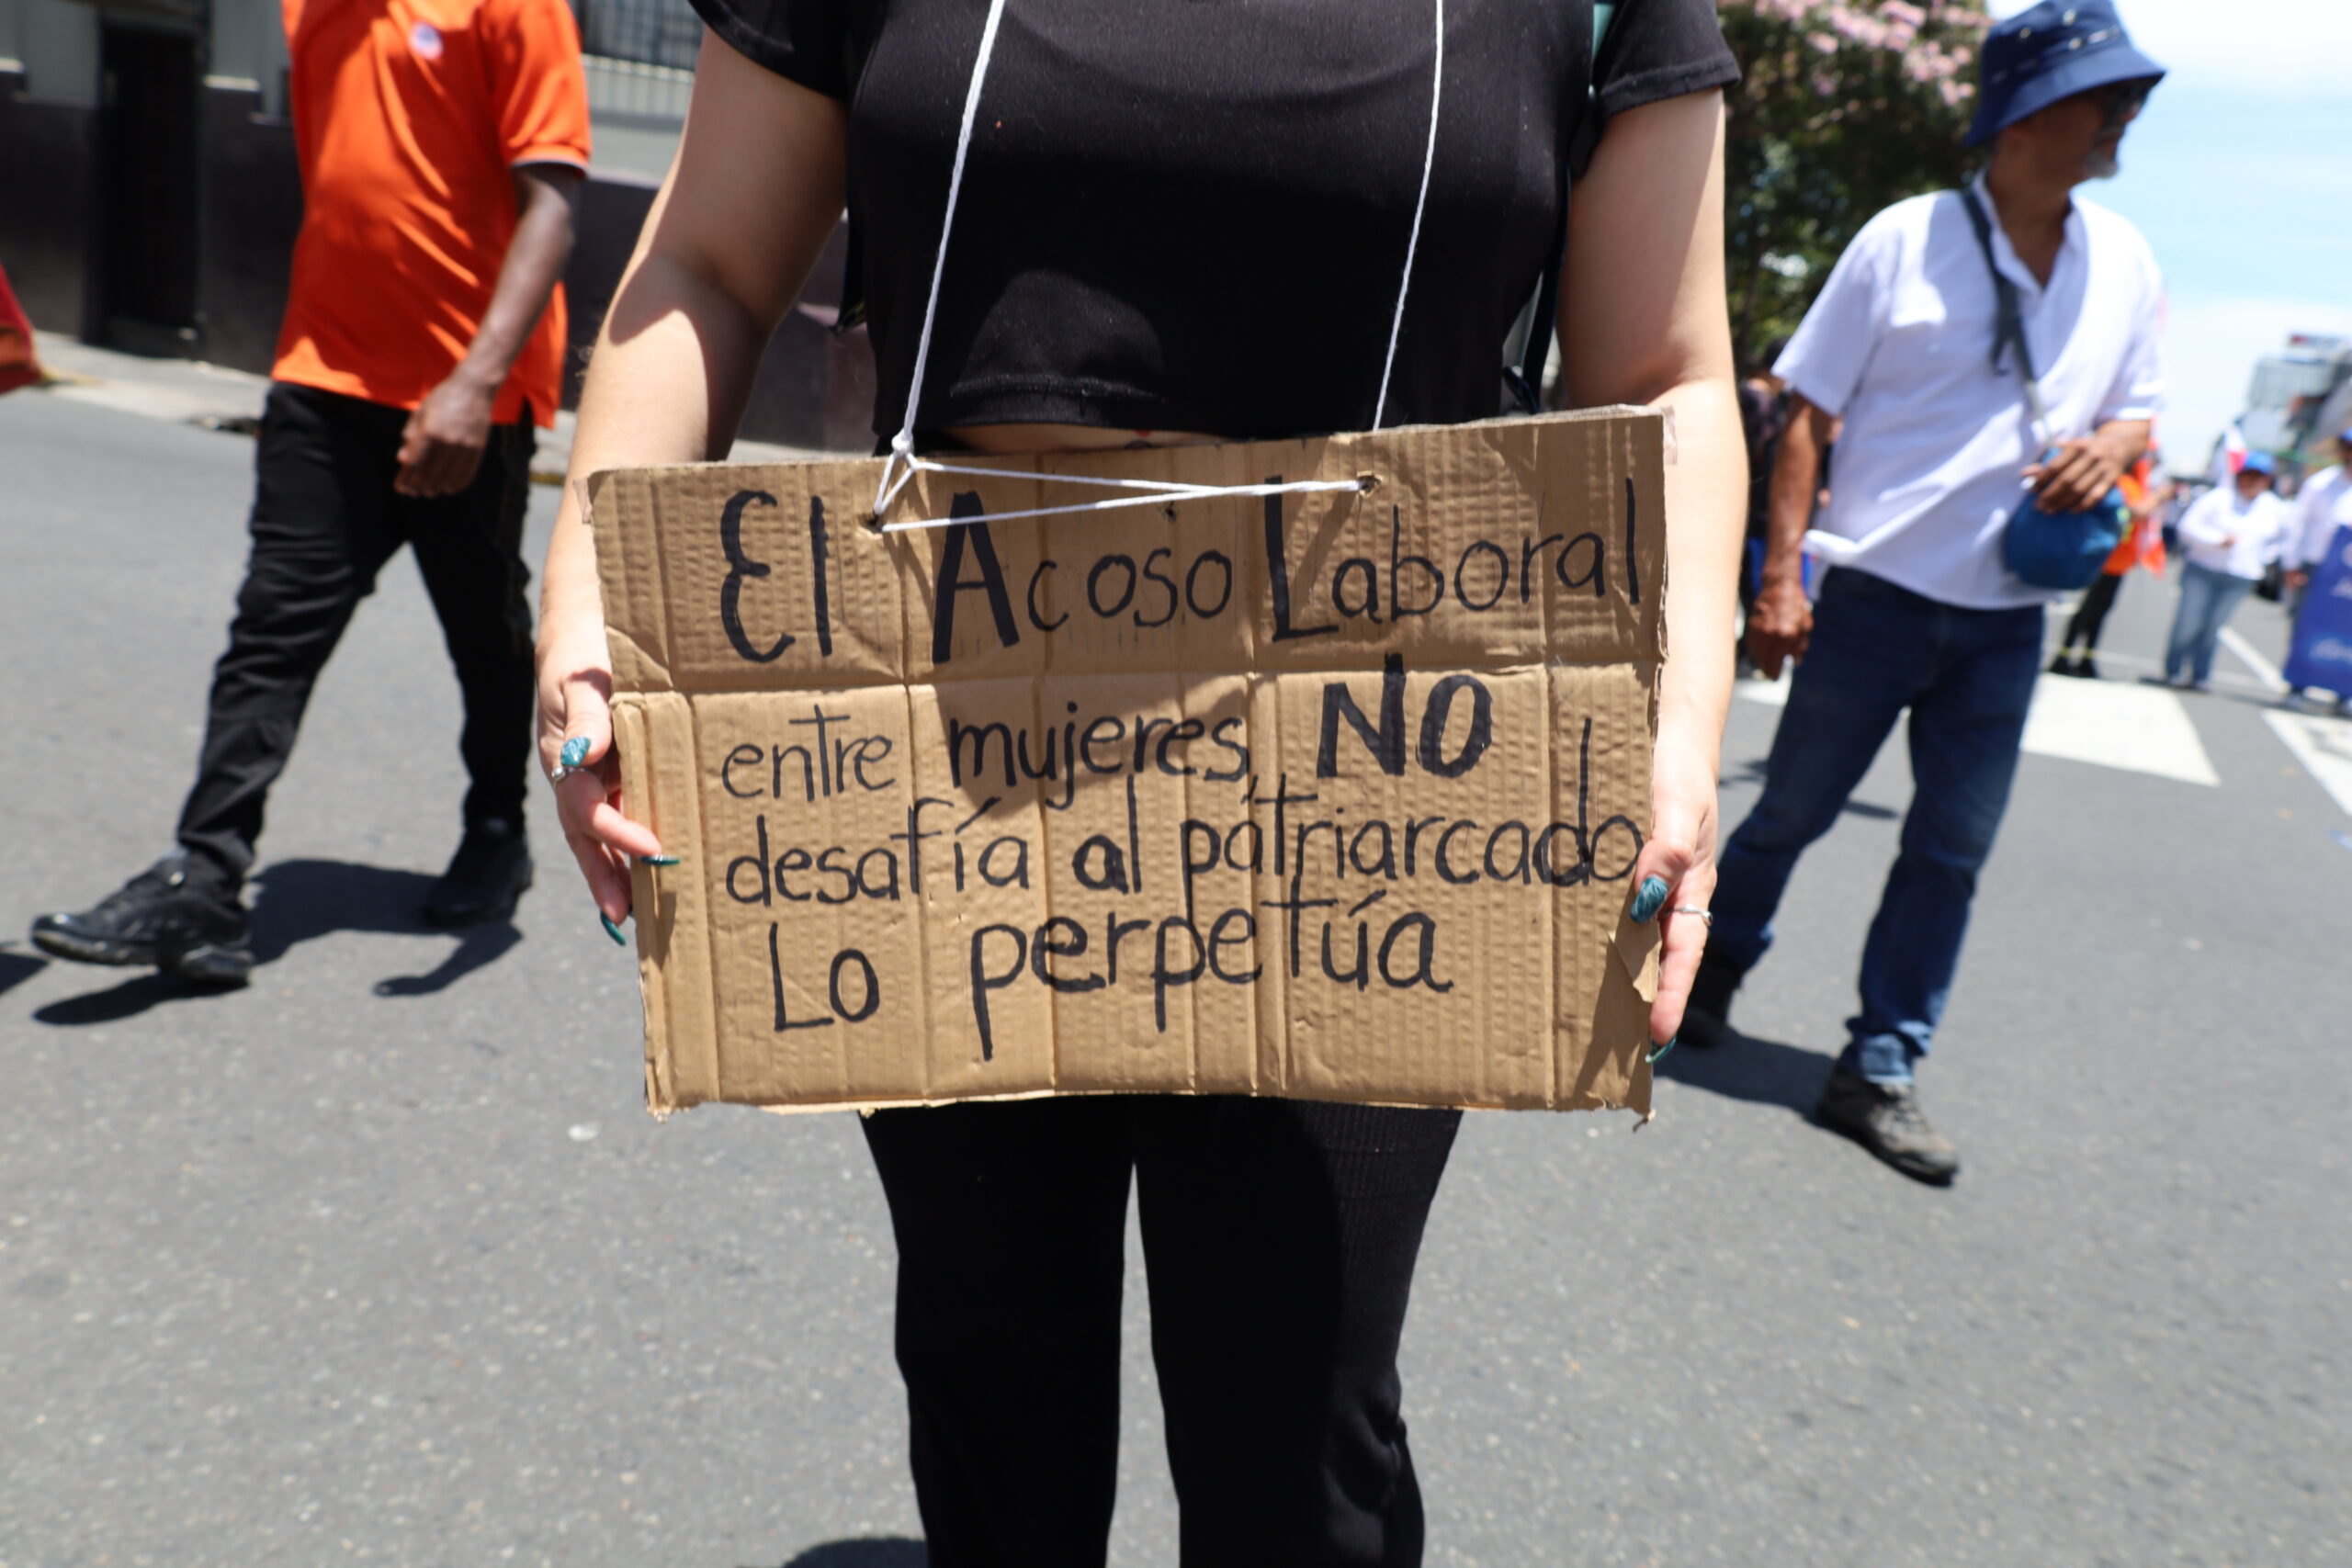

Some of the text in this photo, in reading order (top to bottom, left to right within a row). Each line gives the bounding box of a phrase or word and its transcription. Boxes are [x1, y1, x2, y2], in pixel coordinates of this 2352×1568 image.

[719, 474, 1641, 664] El Acoso Laboral
[721, 704, 896, 801] entre
[1317, 651, 1494, 779] NO
[725, 716, 1646, 926] desafía al patriarcado
[768, 871, 1455, 1062] Lo perpetúa
